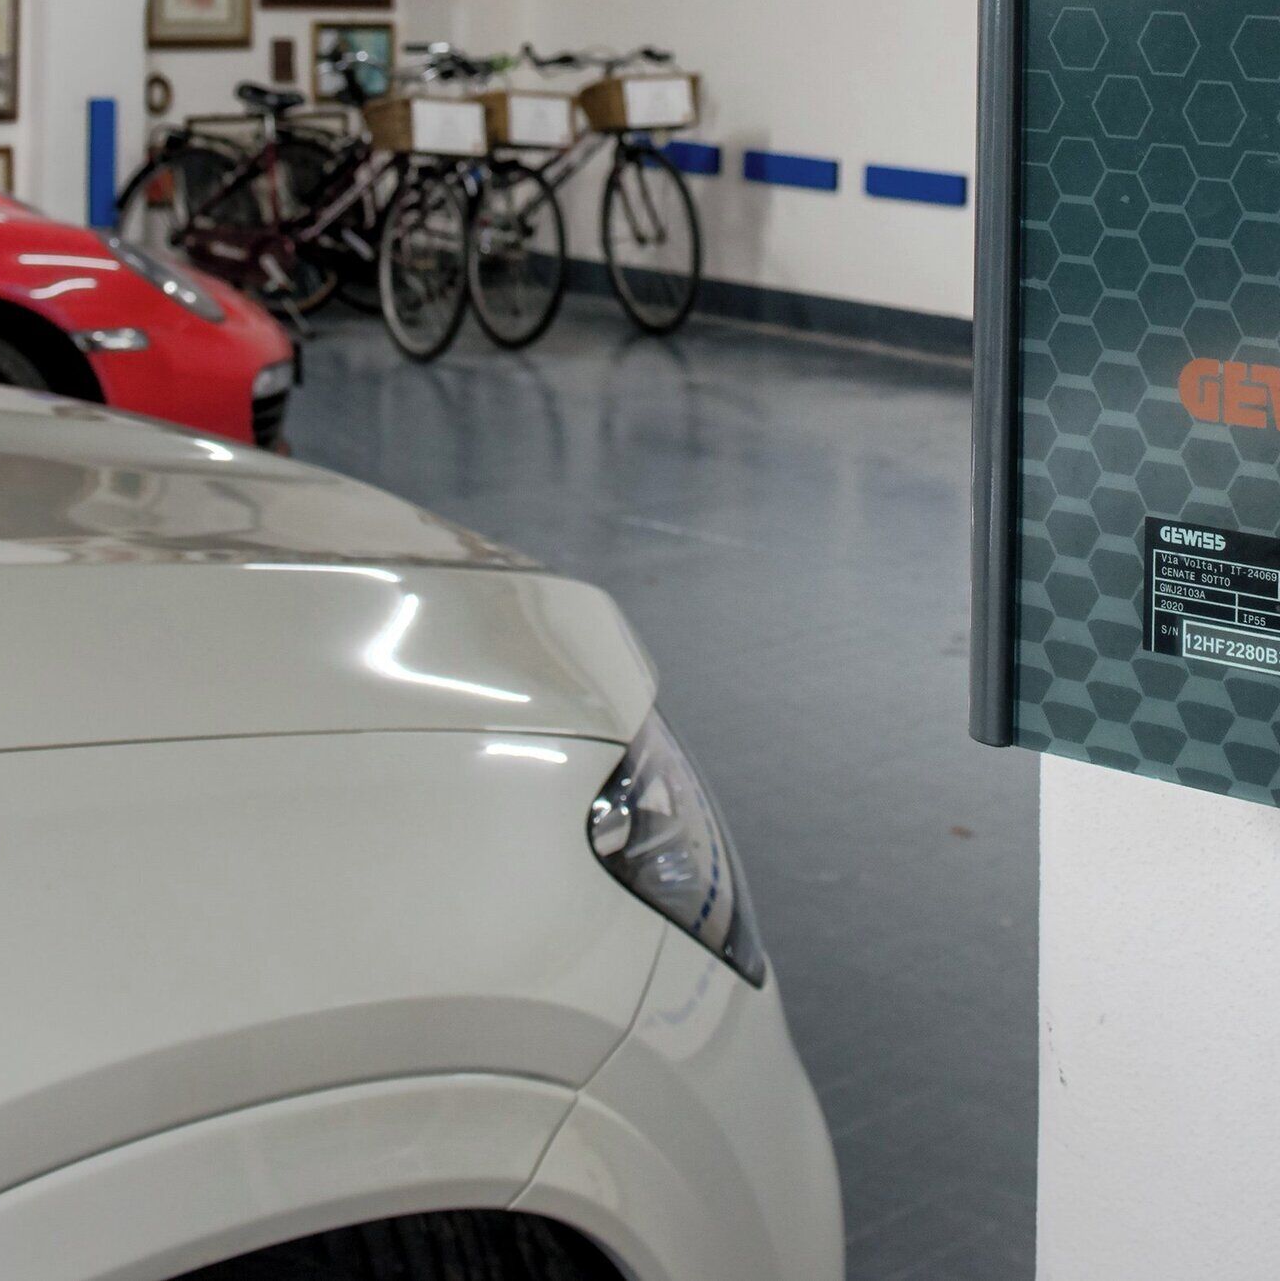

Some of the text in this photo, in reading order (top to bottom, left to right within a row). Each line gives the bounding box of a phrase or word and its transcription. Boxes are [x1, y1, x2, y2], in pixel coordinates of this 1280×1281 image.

[1161, 553, 1179, 565] Via
[1230, 565, 1278, 582] IT-24069
[1161, 566, 1231, 587] CENATE SOTTO
[1160, 582, 1206, 599] GWJ2103A
[1160, 599, 1184, 612] 2020
[1242, 613, 1266, 627] IP55
[1161, 624, 1179, 636] S/N
